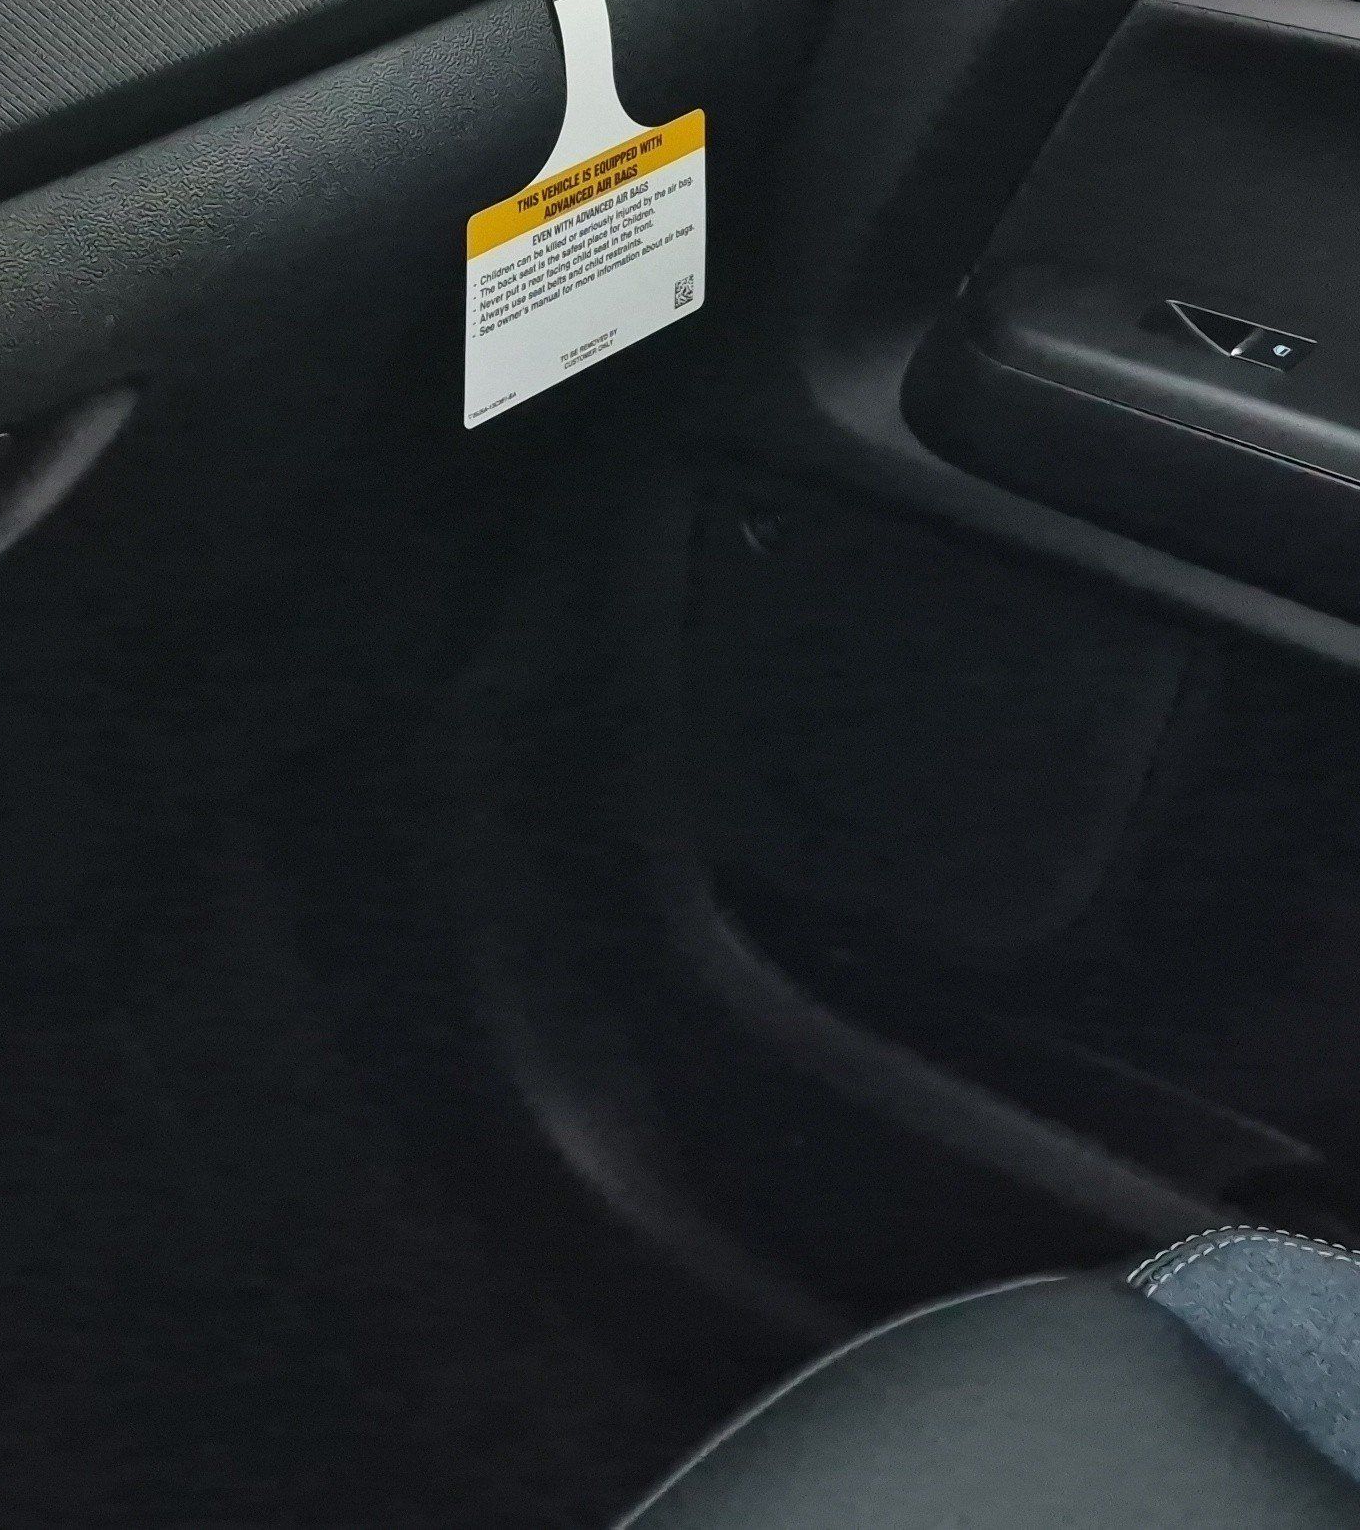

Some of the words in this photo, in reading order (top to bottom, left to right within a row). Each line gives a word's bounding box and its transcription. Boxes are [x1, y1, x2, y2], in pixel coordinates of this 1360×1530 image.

[517, 193, 539, 213] THIS
[542, 172, 580, 201] VEHICLE
[582, 167, 592, 183] IS
[595, 146, 637, 177] EQUIPPED
[640, 134, 663, 155] WITH
[532, 228, 552, 246] EVEN
[554, 218, 574, 235] WITH
[575, 198, 614, 225] ADVANCED
[616, 191, 629, 206] AIR
[630, 181, 649, 199] BAGS
[544, 185, 595, 219] ADVANCED
[596, 176, 612, 195] AIR
[614, 164, 638, 186] BAGS
[480, 262, 515, 285] Children
[516, 254, 532, 268] can
[533, 249, 544, 260] be
[545, 236, 567, 254] killed
[568, 231, 578, 243] or
[579, 213, 614, 238] seriously
[615, 199, 642, 219] injured
[643, 193, 653, 206] by
[654, 188, 666, 201] the
[667, 183, 677, 195] air
[480, 285, 495, 298] The
[497, 273, 517, 287] back
[519, 266, 537, 280] seat
[547, 252, 560, 265] the
[561, 240, 586, 258] safest
[587, 229, 608, 248] place
[609, 223, 621, 235] for
[622, 207, 655, 228] Children.
[480, 293, 503, 311] Never
[505, 285, 520, 300] put
[528, 273, 545, 288] rear
[546, 259, 571, 276] facing
[572, 250, 592, 266] child
[593, 240, 610, 255] seat
[611, 235, 619, 246] in
[620, 229, 632, 242] the
[479, 322, 495, 337] See
[497, 306, 530, 328] owner's
[531, 289, 561, 312] manual
[562, 283, 574, 296] for
[575, 274, 596, 289] more
[597, 250, 641, 278] information
[641, 238, 663, 256] about
[664, 232, 675, 244] air
[480, 301, 510, 325] Always
[511, 295, 527, 308] use
[528, 284, 546, 300] seat
[547, 274, 567, 290] belts
[568, 264, 584, 279] and
[585, 255, 604, 271] child
